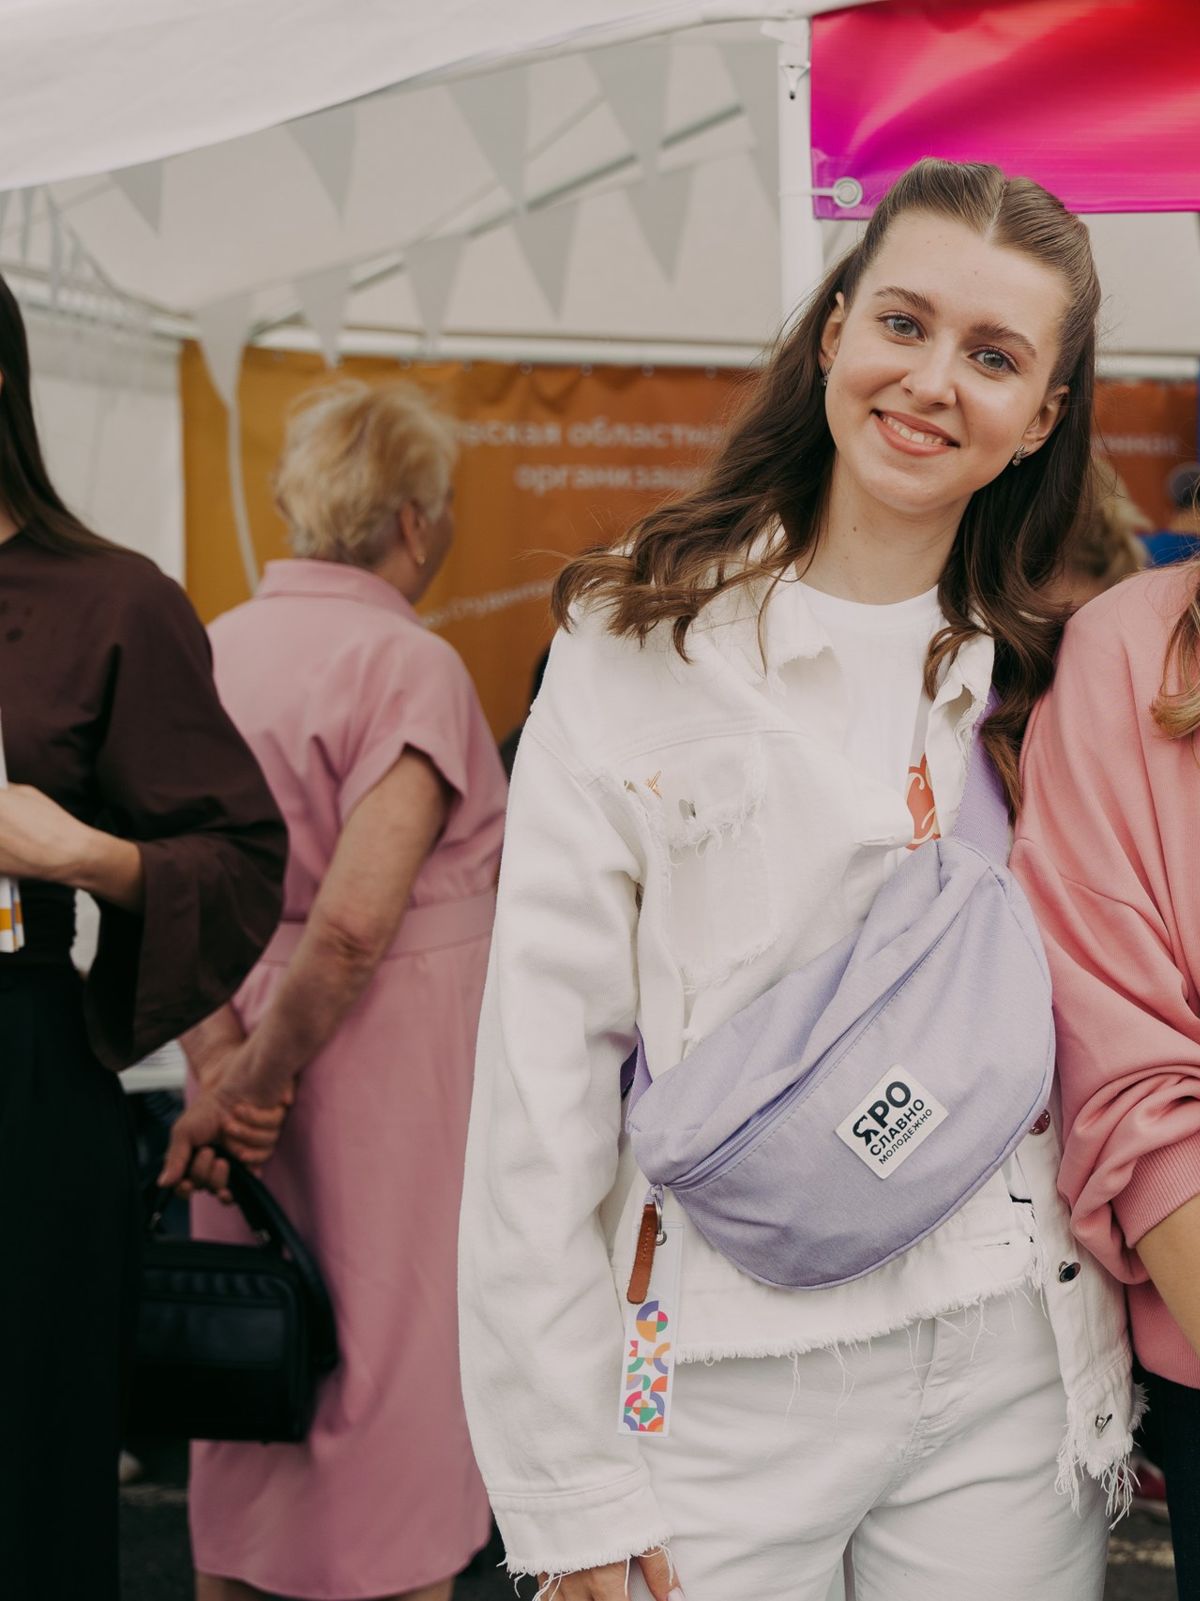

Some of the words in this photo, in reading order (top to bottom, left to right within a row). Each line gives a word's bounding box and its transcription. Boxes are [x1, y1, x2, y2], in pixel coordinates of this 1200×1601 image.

[852, 1081, 912, 1147] ЯРО
[869, 1098, 925, 1157] СЛАВНО
[878, 1107, 933, 1166] МОЛОДЕЖНО
